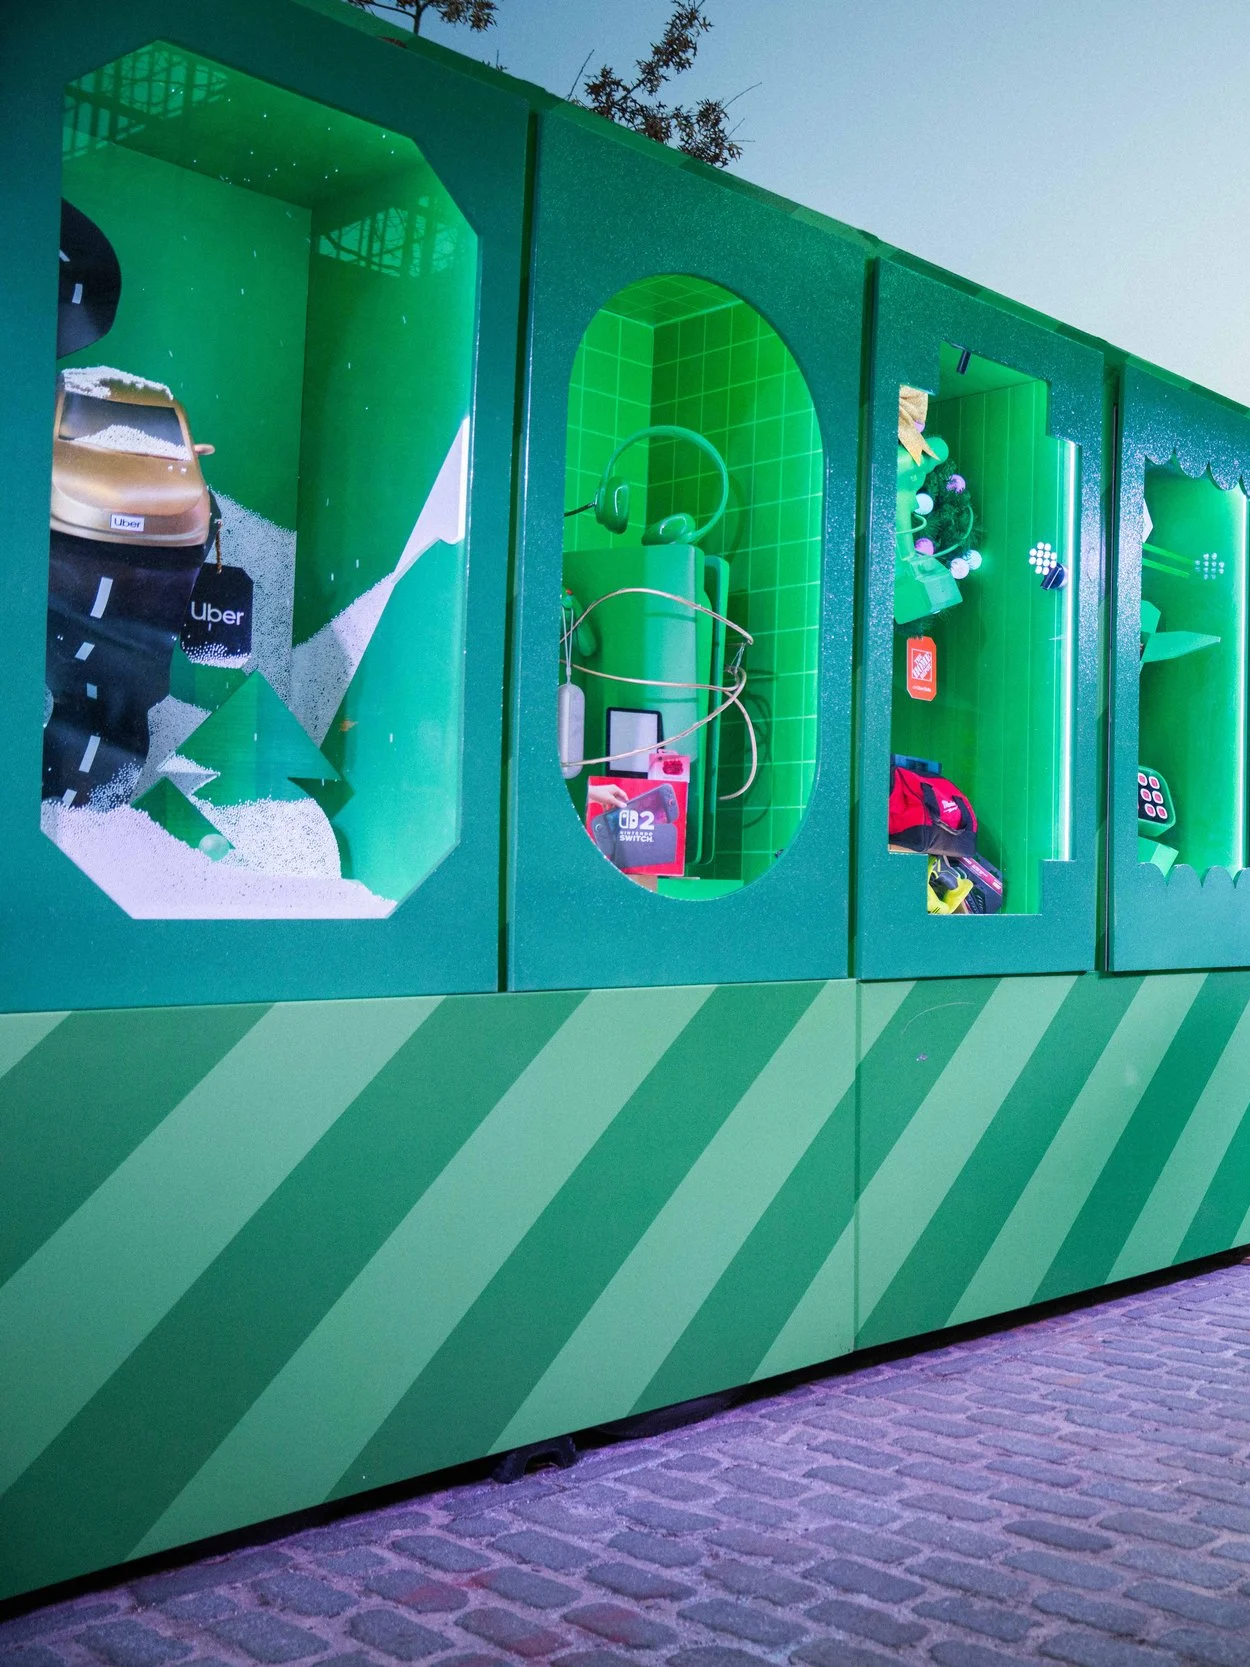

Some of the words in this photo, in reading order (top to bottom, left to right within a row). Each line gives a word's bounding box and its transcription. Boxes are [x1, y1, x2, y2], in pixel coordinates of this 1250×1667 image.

[113, 518, 141, 528] Uber
[190, 601, 245, 626] Uber
[639, 810, 655, 831] 2
[619, 834, 653, 843] SWITCH
